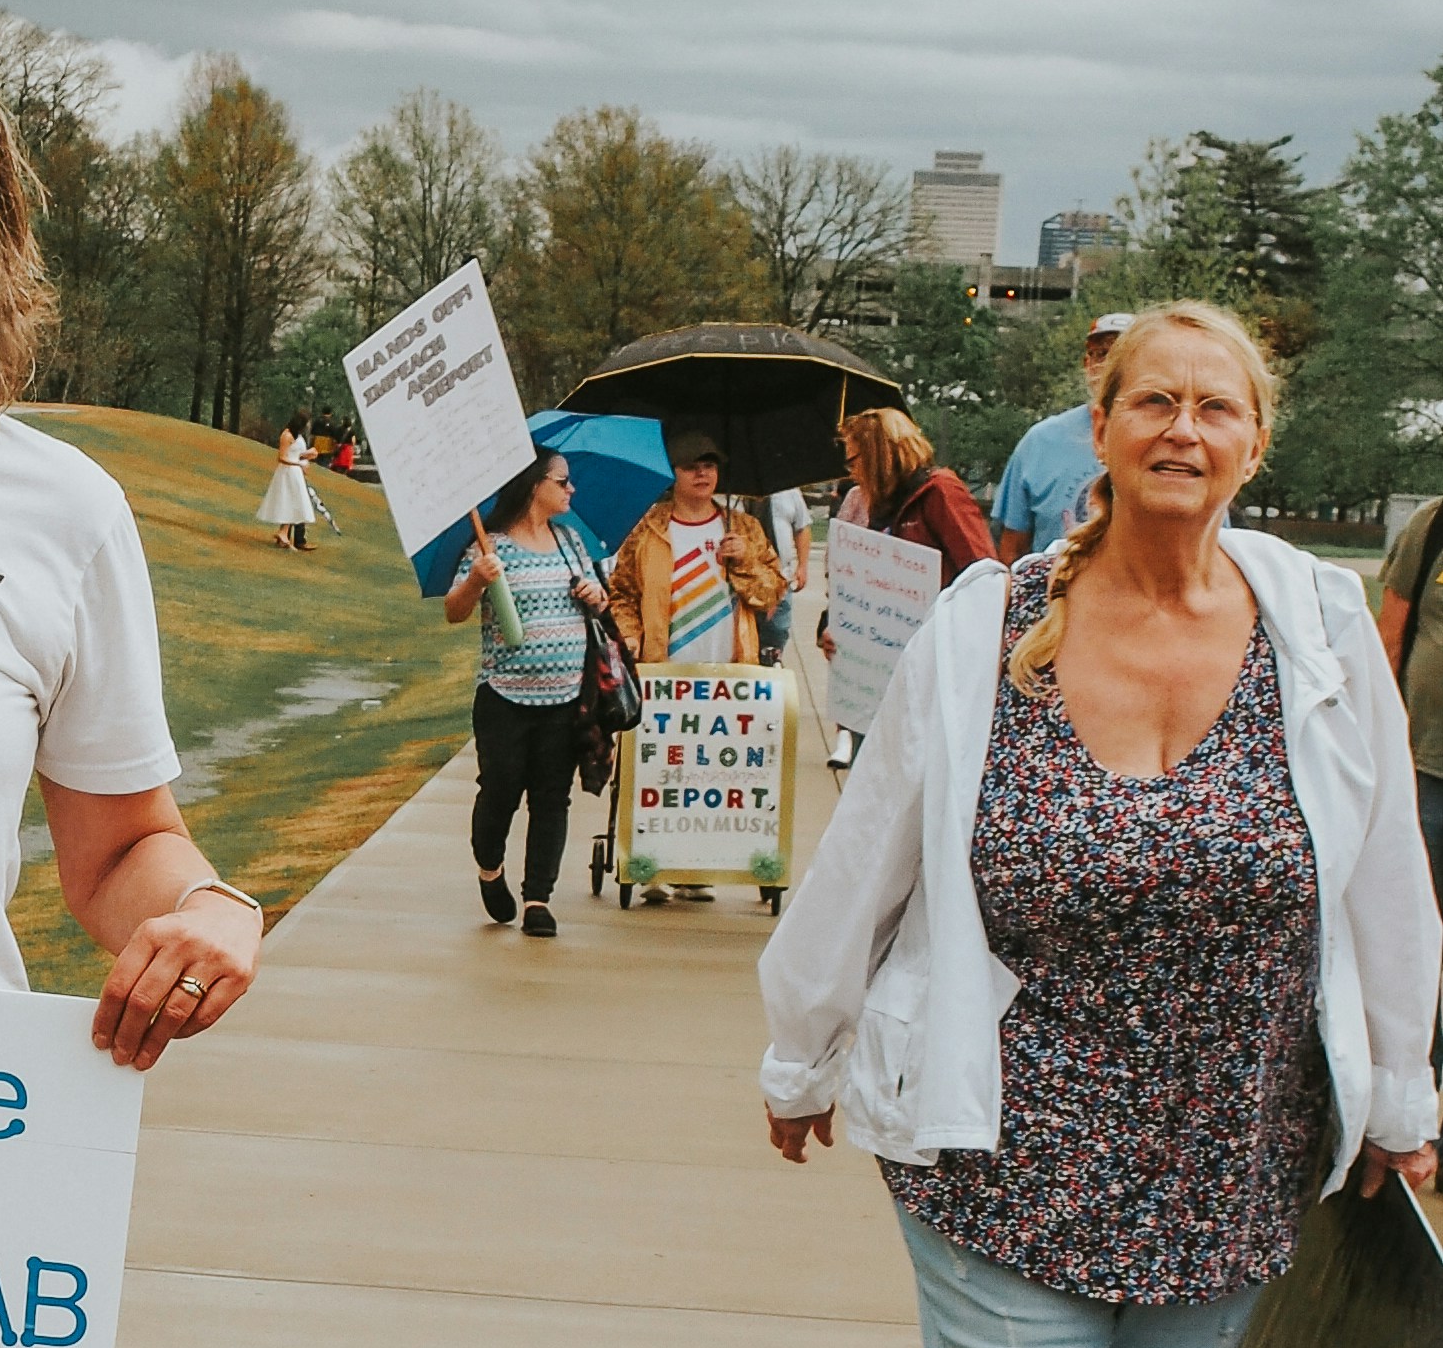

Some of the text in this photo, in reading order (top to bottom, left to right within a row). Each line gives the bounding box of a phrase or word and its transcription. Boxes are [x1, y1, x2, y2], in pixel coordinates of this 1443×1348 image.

[356, 317, 428, 381] HANDS
[362, 334, 447, 408] IMPEACH
[407, 359, 446, 400] AND
[422, 343, 493, 407] DEPORT
[837, 524, 927, 573] Protect those
[837, 583, 871, 611] Hands
[654, 712, 754, 735] THAT
[648, 816, 778, 837] ELON MUSK
